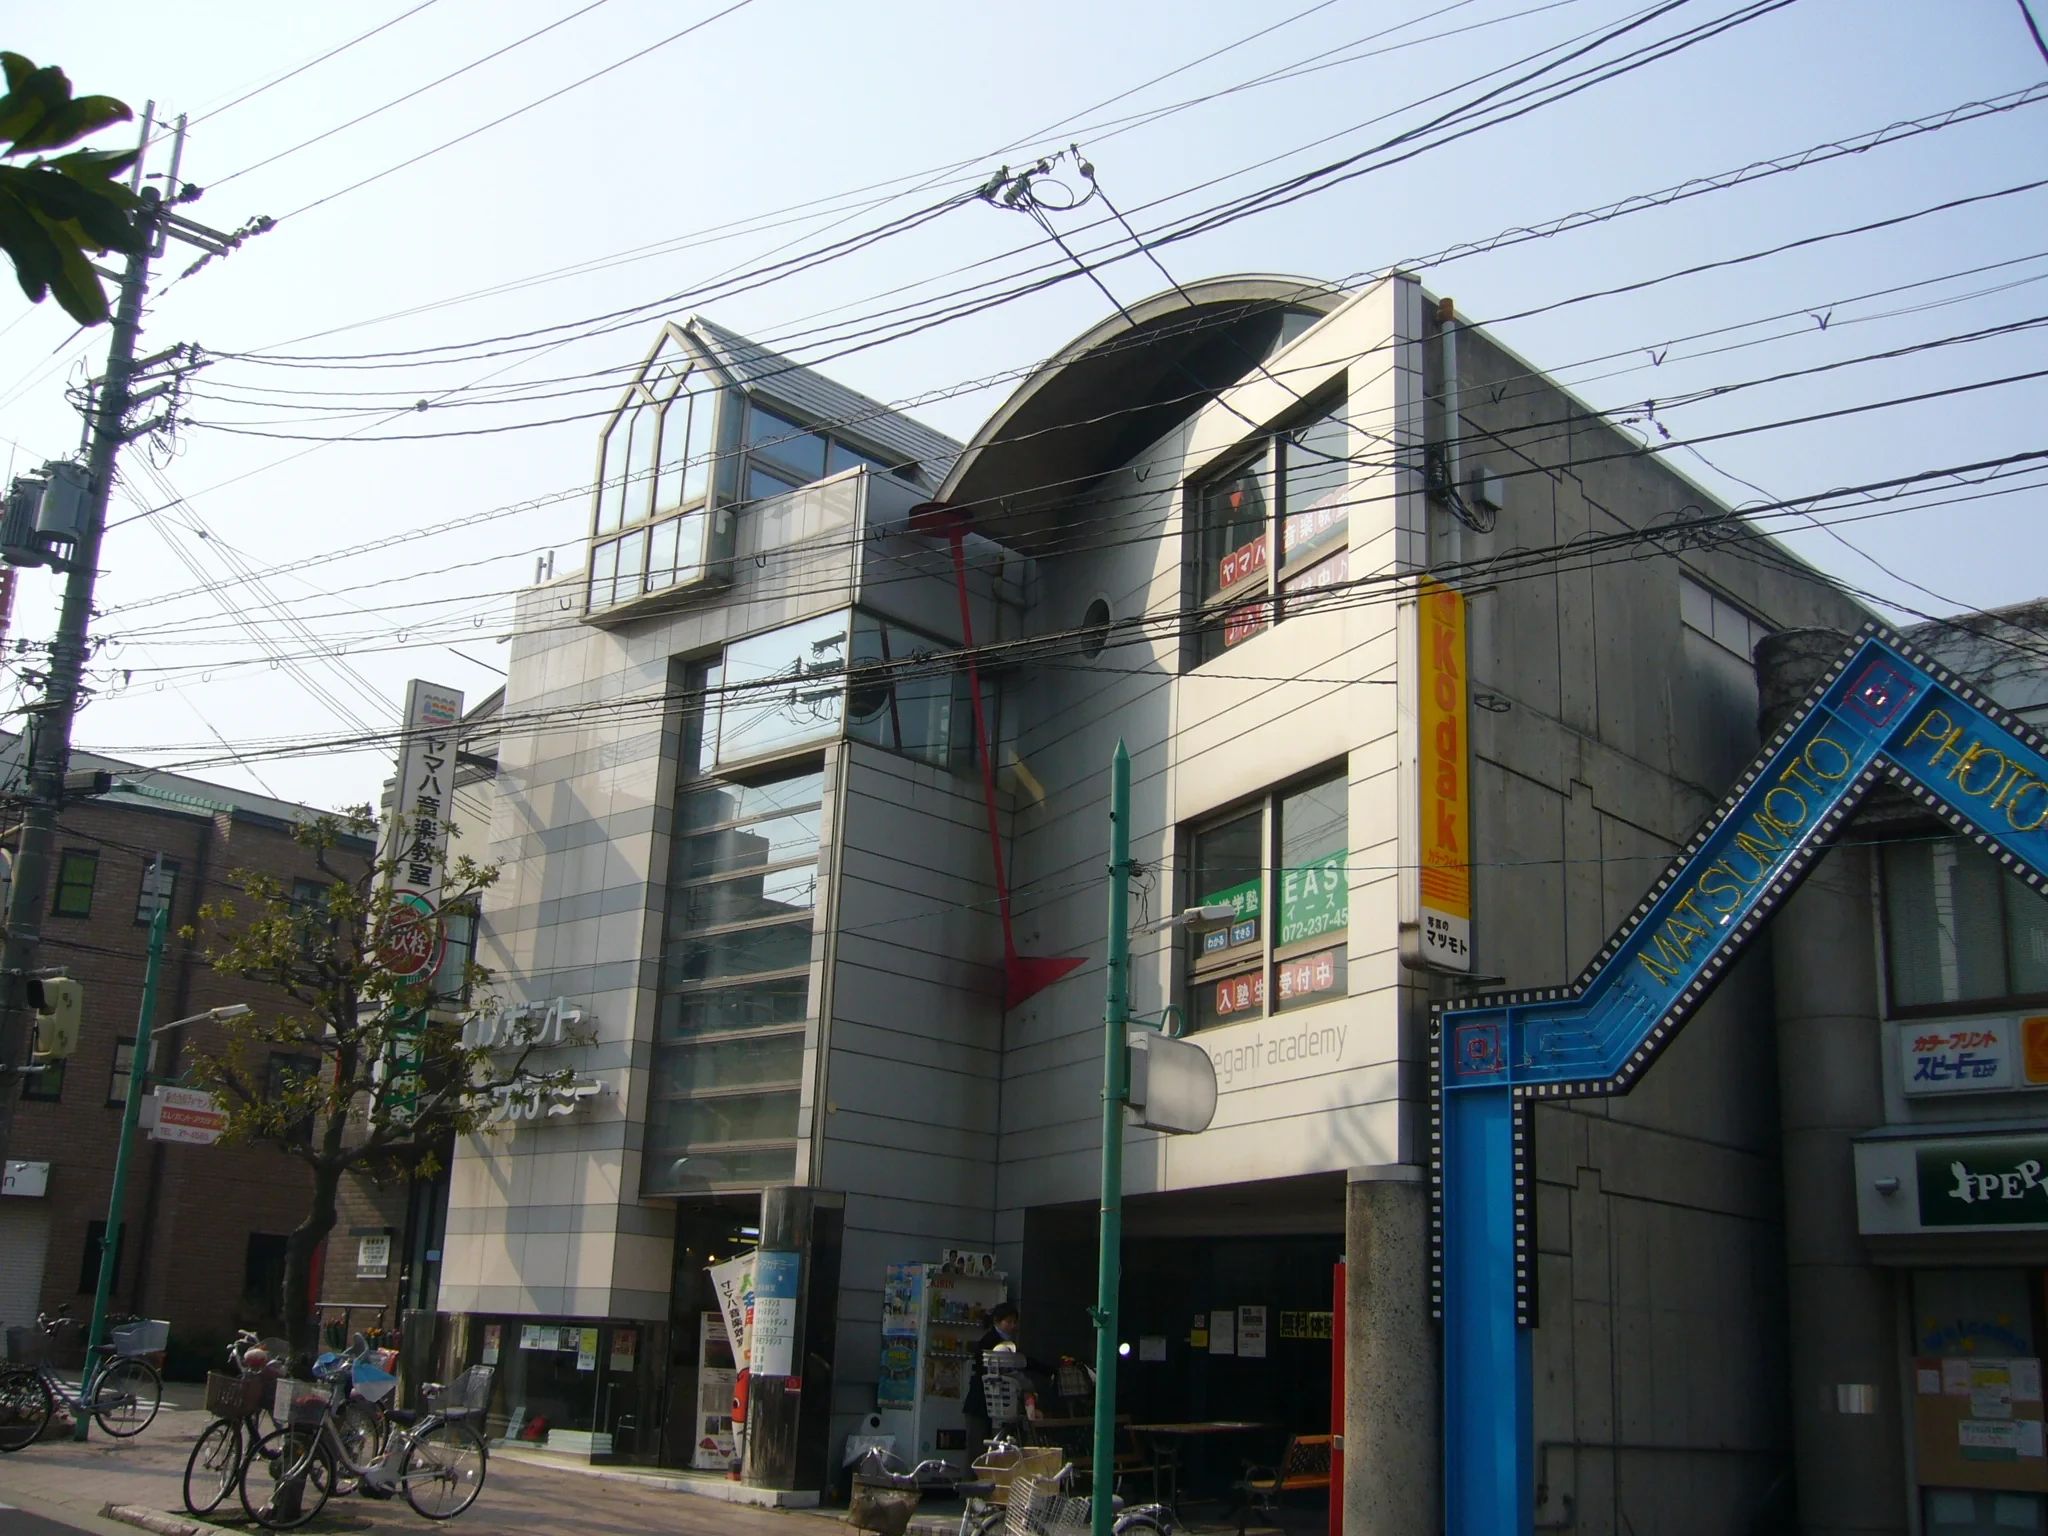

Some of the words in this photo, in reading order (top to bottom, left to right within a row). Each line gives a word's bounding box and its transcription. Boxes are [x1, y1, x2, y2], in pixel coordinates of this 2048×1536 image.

[1221, 545, 1266, 583] ヤマハ
[1432, 622, 1459, 854] Kodak
[1903, 708, 2048, 832] PHOTO
[408, 735, 447, 887] ヤマハ音楽教室
[1284, 857, 1348, 905] EAS
[1637, 737, 1852, 988] MATSUMOTO
[1426, 930, 1468, 956] マツモト
[1218, 978, 1264, 1011] 入塾生
[1279, 961, 1331, 997] 受付中
[1267, 1022, 1348, 1067] academy
[1911, 1030, 1998, 1053] カラープリント
[1977, 1160, 2048, 1201] PEP
